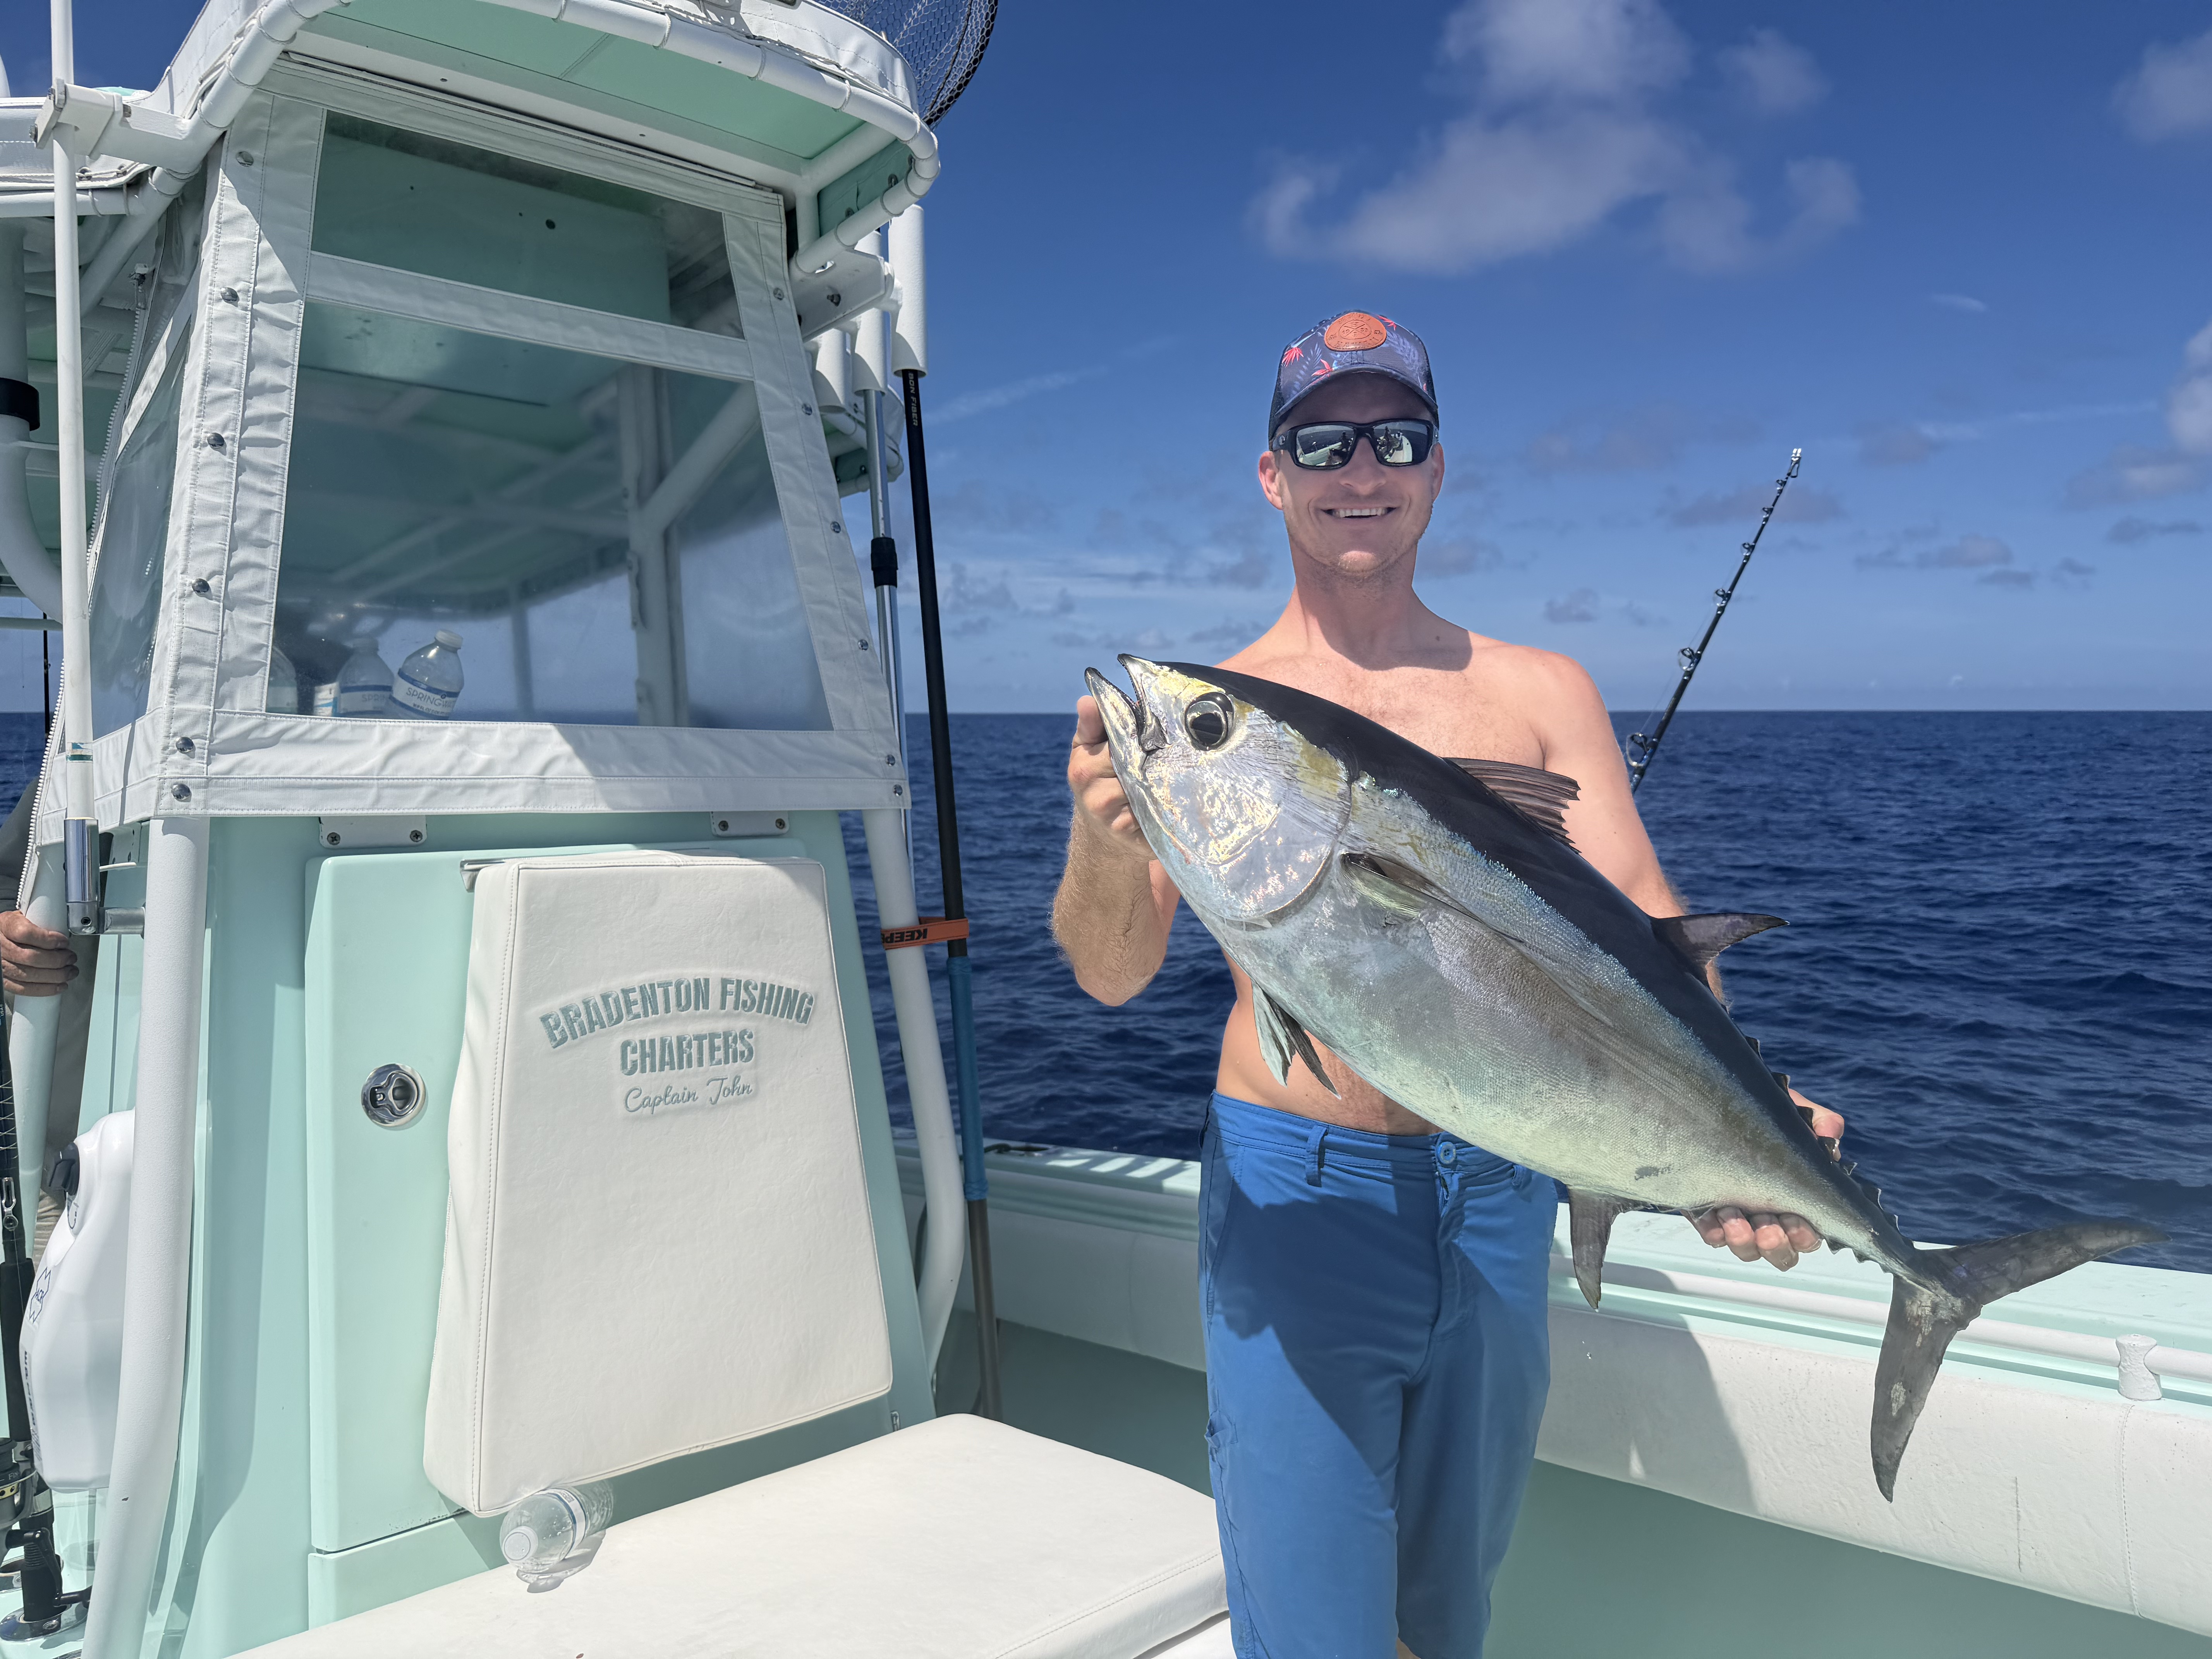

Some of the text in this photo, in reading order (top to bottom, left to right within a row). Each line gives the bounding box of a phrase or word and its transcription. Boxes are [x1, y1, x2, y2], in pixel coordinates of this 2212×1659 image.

[406, 687, 442, 707] SPRING
[539, 977, 814, 1049] BRADENTON FISHING
[620, 1029, 754, 1076] CHARTERS
[623, 1074, 753, 1114] Captain John
